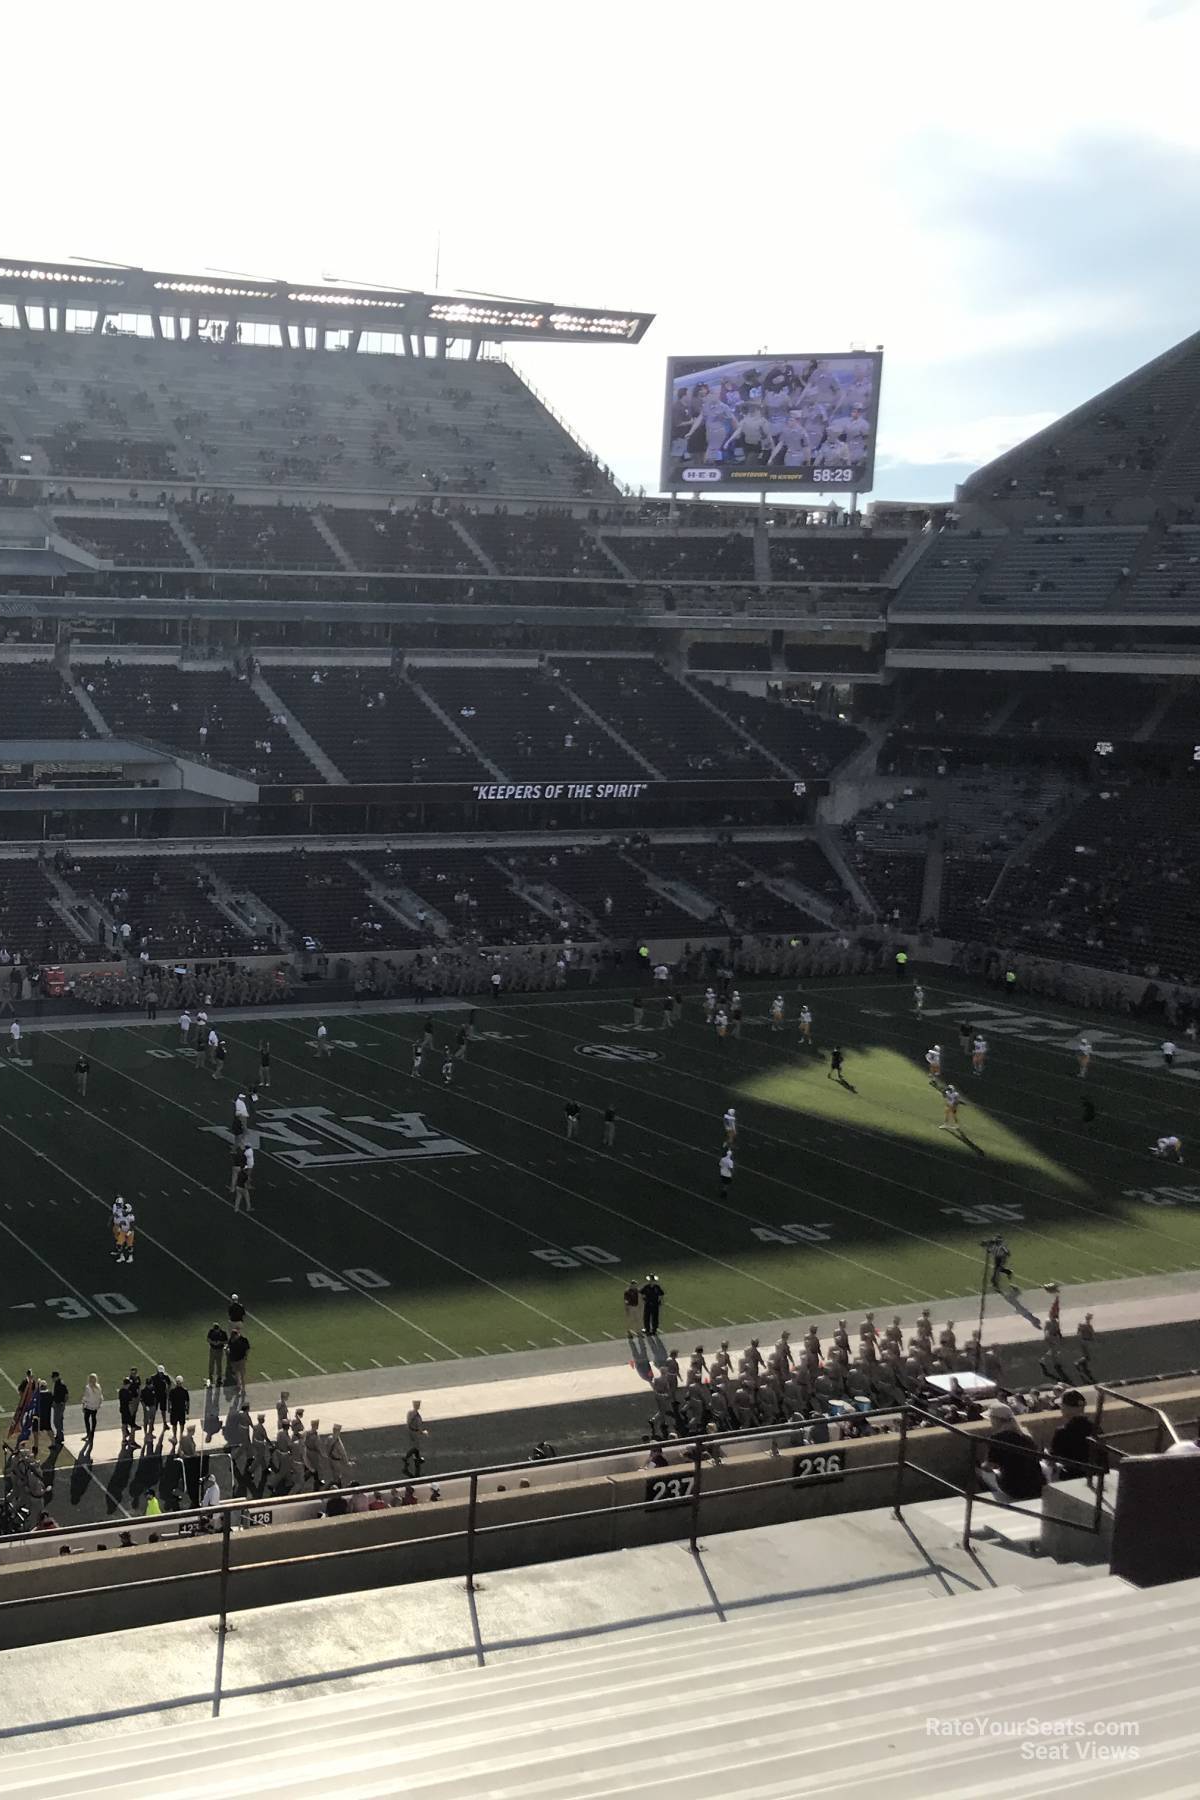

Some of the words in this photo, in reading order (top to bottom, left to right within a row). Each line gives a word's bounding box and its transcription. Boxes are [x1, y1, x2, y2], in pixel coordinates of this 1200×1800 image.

[812, 469, 853, 482] 58:29
[544, 785, 564, 799] OF
[567, 784, 594, 798] THE
[938, 1203, 1024, 1224] 30
[750, 1223, 831, 1244] 40
[528, 1244, 622, 1269] 50
[305, 1267, 392, 1293] 40
[45, 1291, 139, 1321] 30
[799, 1454, 842, 1478] 236
[652, 1476, 695, 1501] 237
